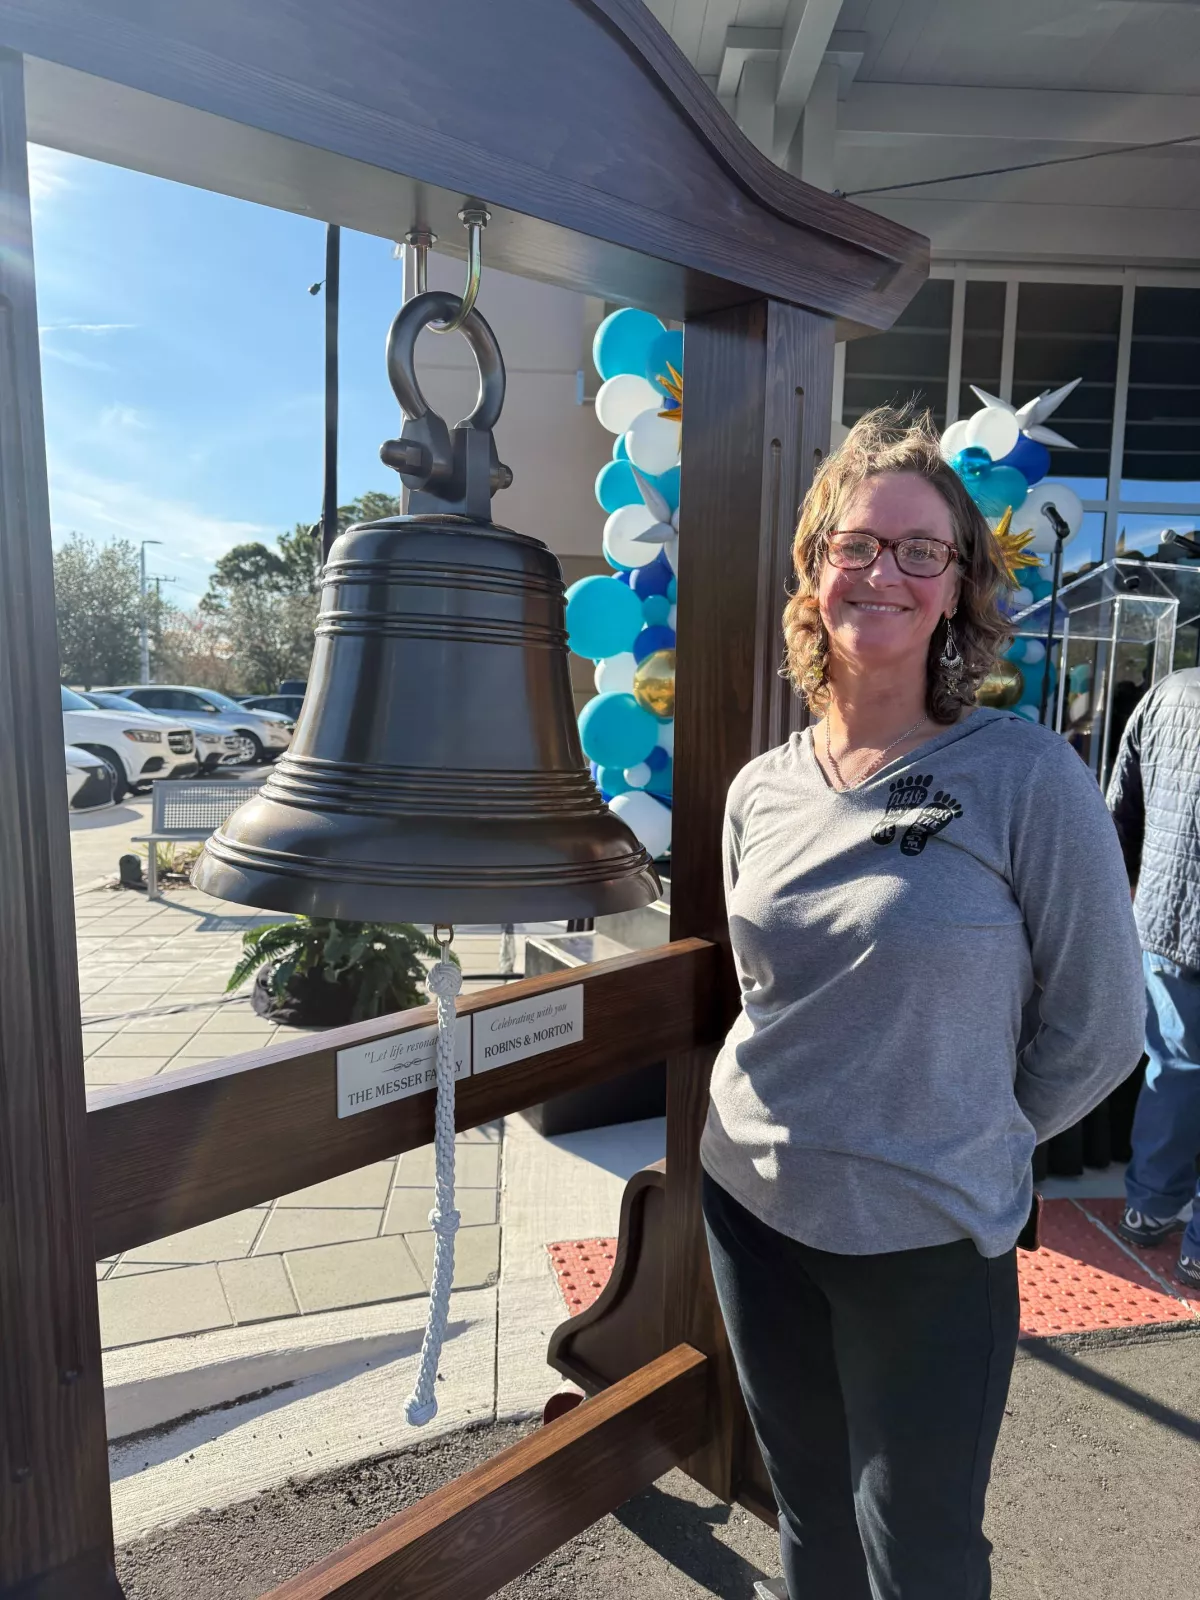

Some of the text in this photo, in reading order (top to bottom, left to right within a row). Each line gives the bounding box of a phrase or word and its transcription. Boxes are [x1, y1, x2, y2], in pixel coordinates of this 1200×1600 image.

[490, 1003, 568, 1032] Celebrating with you
[389, 1044, 404, 1060] life
[406, 1035, 439, 1053] resonat
[484, 1021, 574, 1059] ROBINS & MORTON
[348, 1060, 463, 1106] THE MESSER FAY
